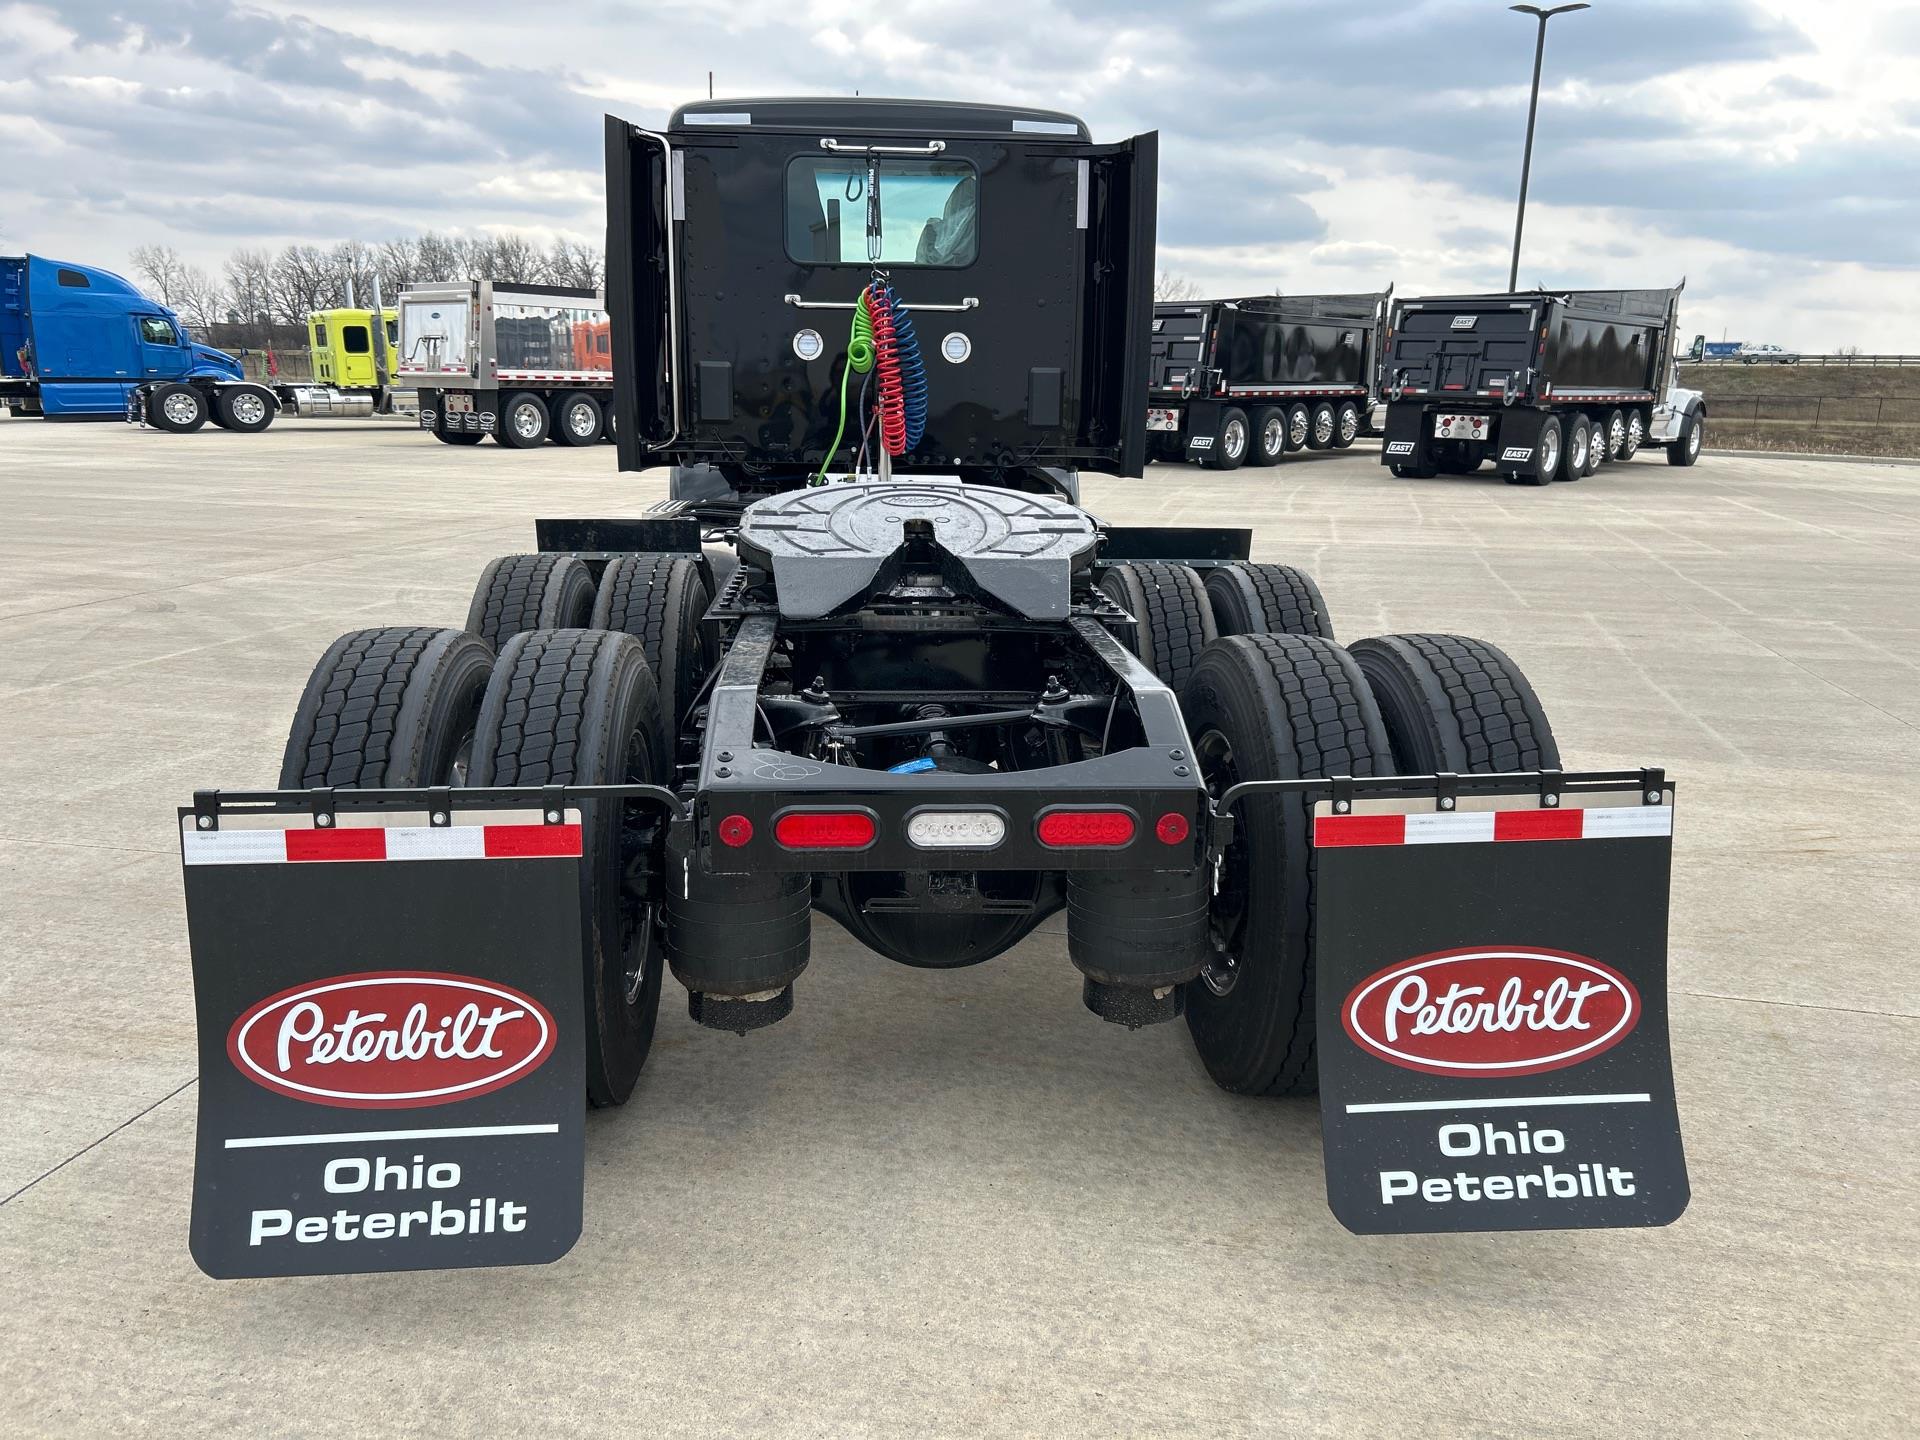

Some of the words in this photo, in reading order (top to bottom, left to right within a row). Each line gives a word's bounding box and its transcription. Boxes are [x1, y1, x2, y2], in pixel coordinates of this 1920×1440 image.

[1390, 443, 1411, 452] EAST
[1505, 449, 1529, 458] EAST
[1384, 974, 1611, 1043] Peterbilt
[278, 1001, 525, 1073] Peterbilt
[1438, 1121, 1565, 1157] Ohio
[323, 1155, 461, 1194] Ohio
[1379, 1163, 1636, 1205] Peterbilt
[249, 1197, 528, 1246] Peterbilt
